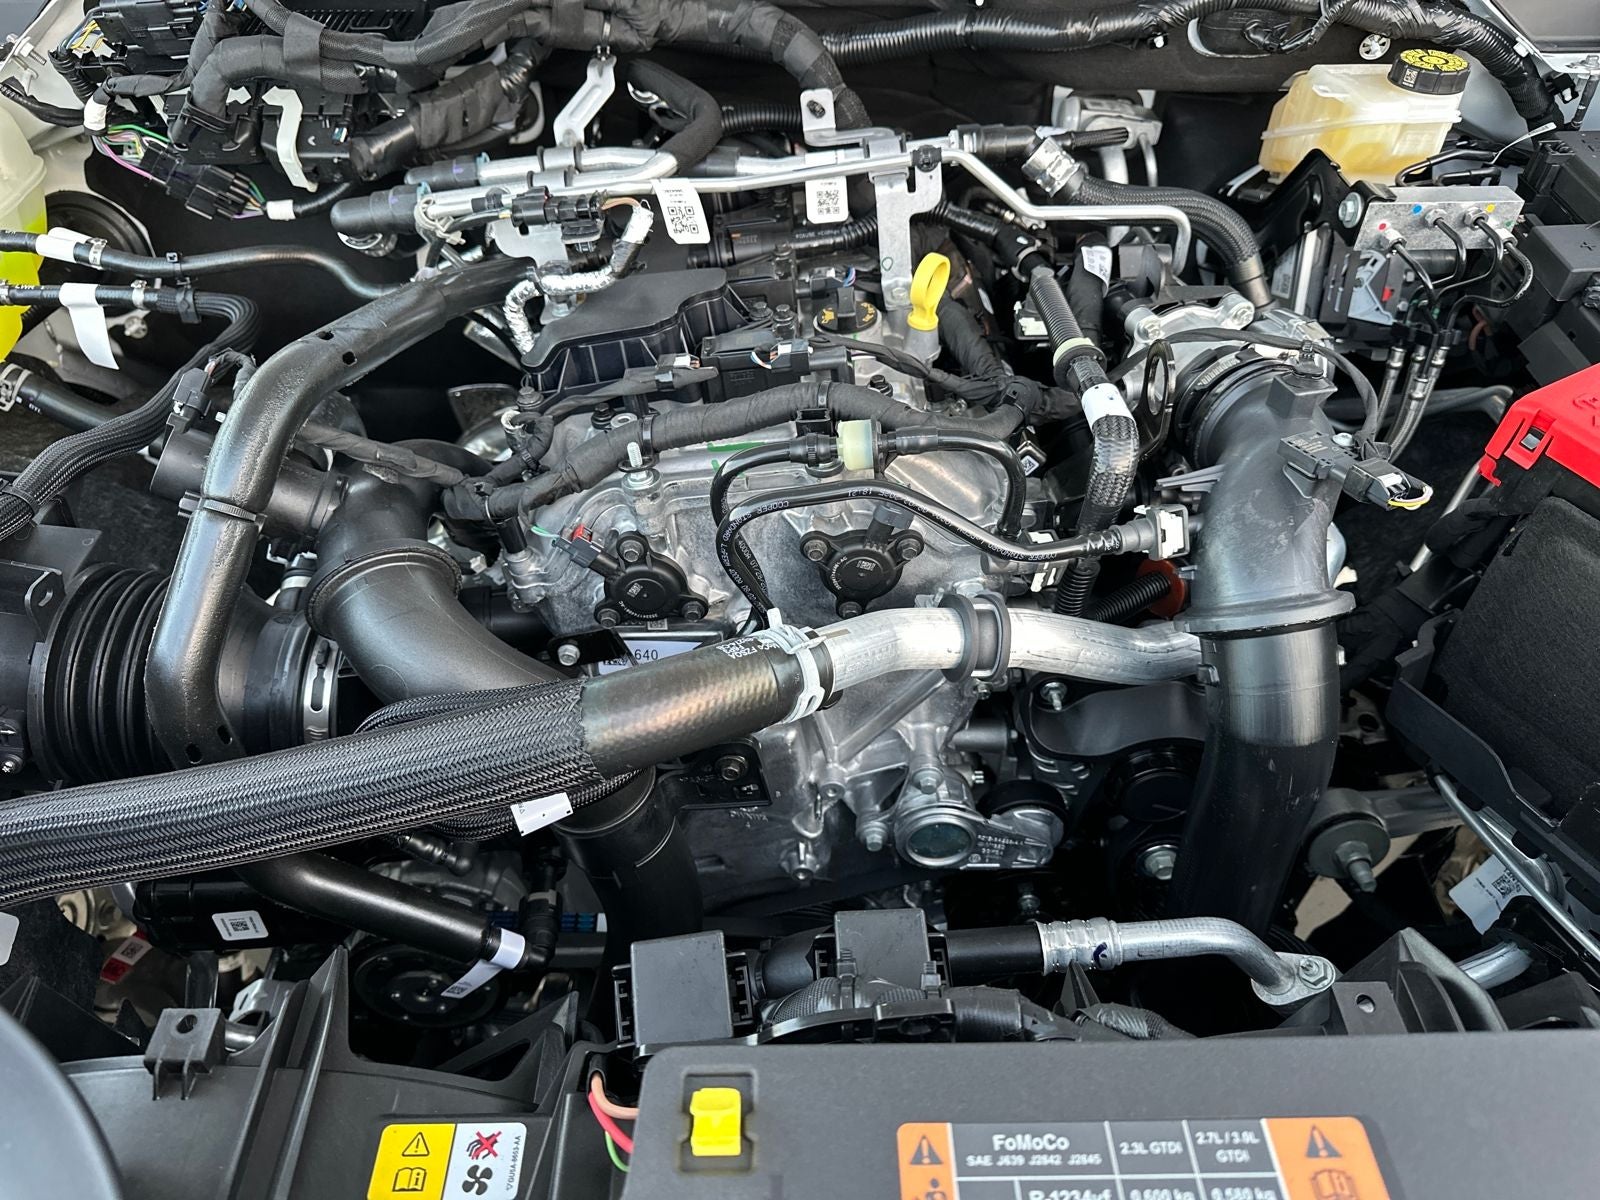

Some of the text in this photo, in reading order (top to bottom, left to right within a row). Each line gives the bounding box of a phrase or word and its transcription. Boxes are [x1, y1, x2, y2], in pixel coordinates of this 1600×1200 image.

[722, 511, 752, 542] STANDARD
[634, 649, 659, 660] 640
[992, 1133, 1070, 1151] FoMoCo
[965, 1155, 994, 1167] SAE
